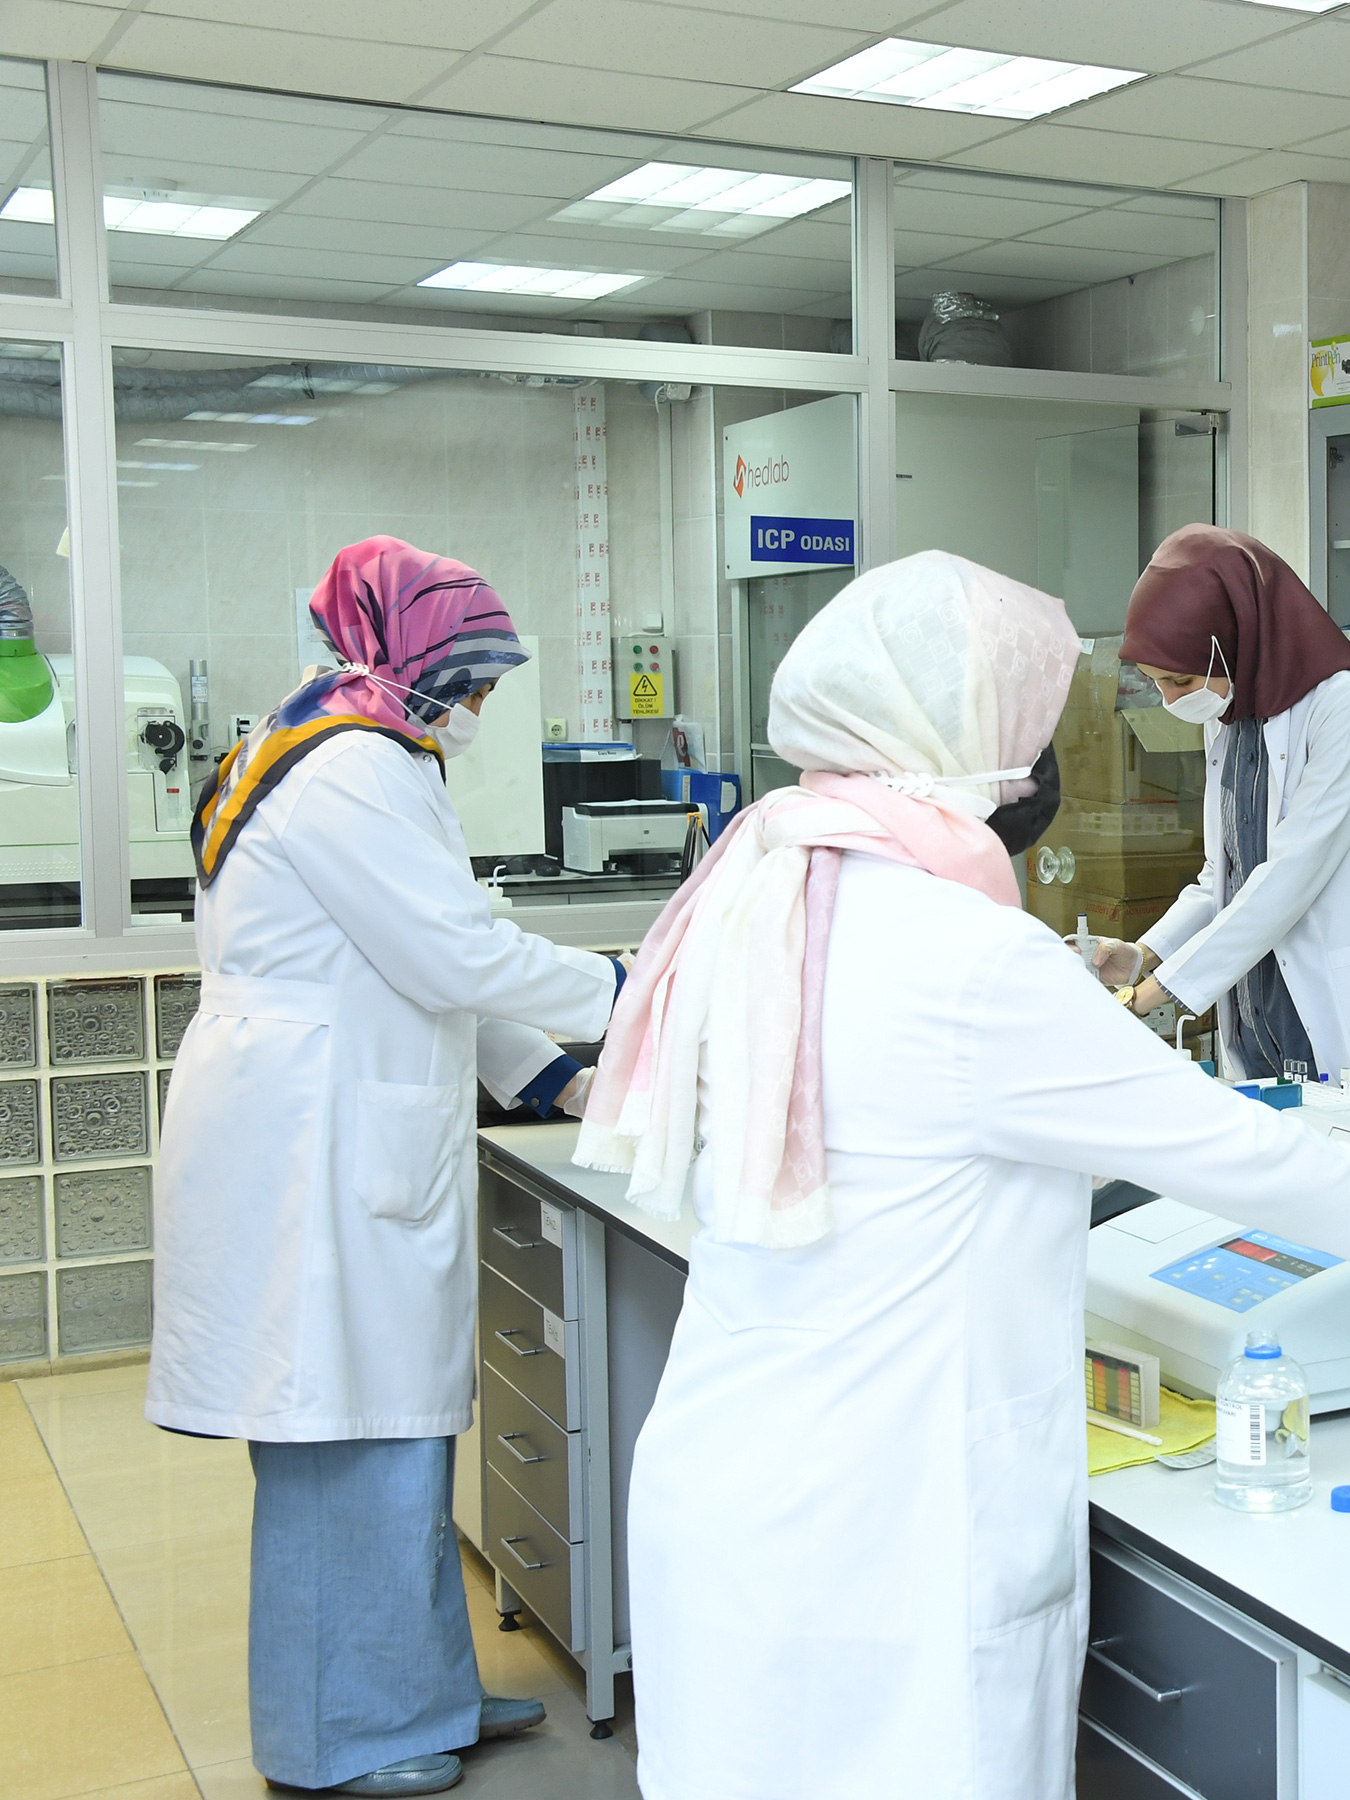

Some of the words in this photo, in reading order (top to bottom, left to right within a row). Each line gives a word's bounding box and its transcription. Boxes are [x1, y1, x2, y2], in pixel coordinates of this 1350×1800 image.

[1311, 350, 1341, 368] PrintPen
[747, 454, 789, 489] hedlab
[757, 528, 796, 550] ICP
[800, 535, 850, 552] ODASI
